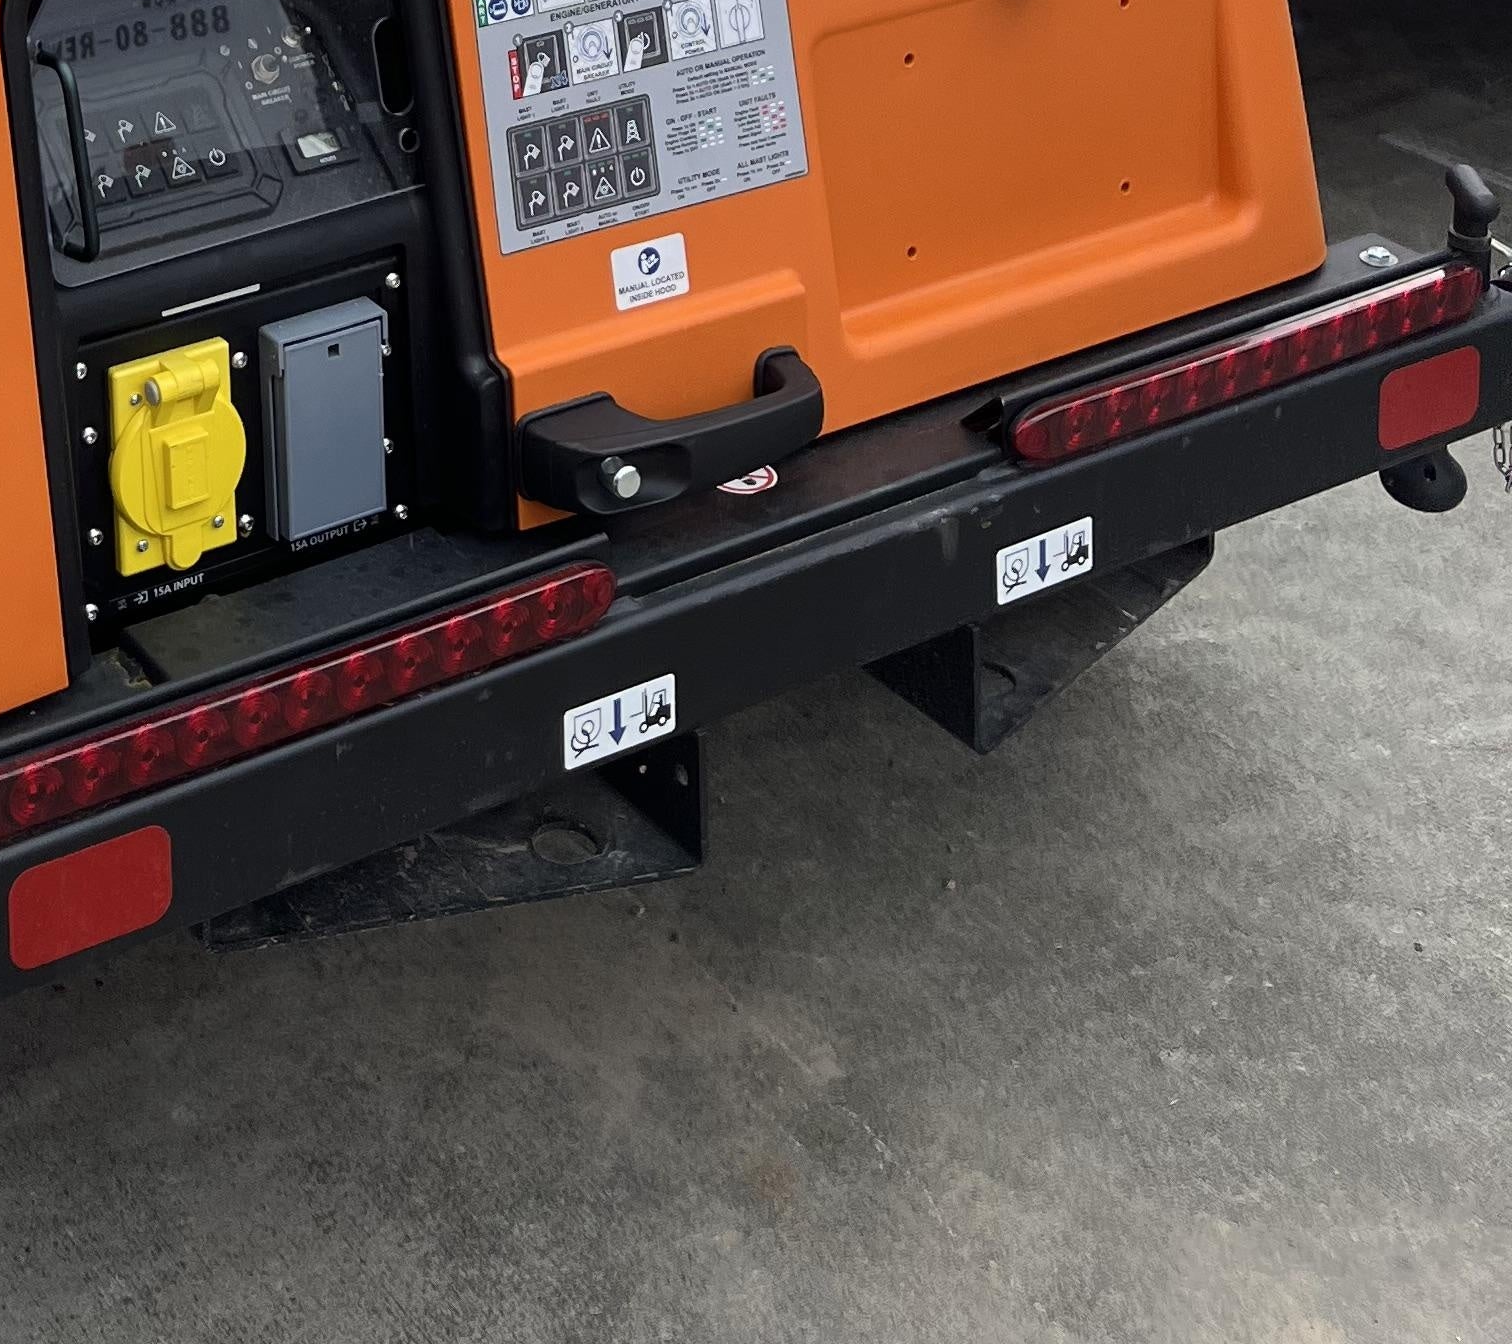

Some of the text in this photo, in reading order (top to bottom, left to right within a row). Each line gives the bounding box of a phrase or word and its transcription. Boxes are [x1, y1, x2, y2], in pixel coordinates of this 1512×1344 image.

[510, 56, 520, 90] STOP
[618, 271, 685, 295] MANUAL LOCATED
[629, 284, 677, 303] INSIDE HOOD
[290, 526, 349, 552] 15A OUTPUT
[153, 573, 205, 598] 15A INPUT
